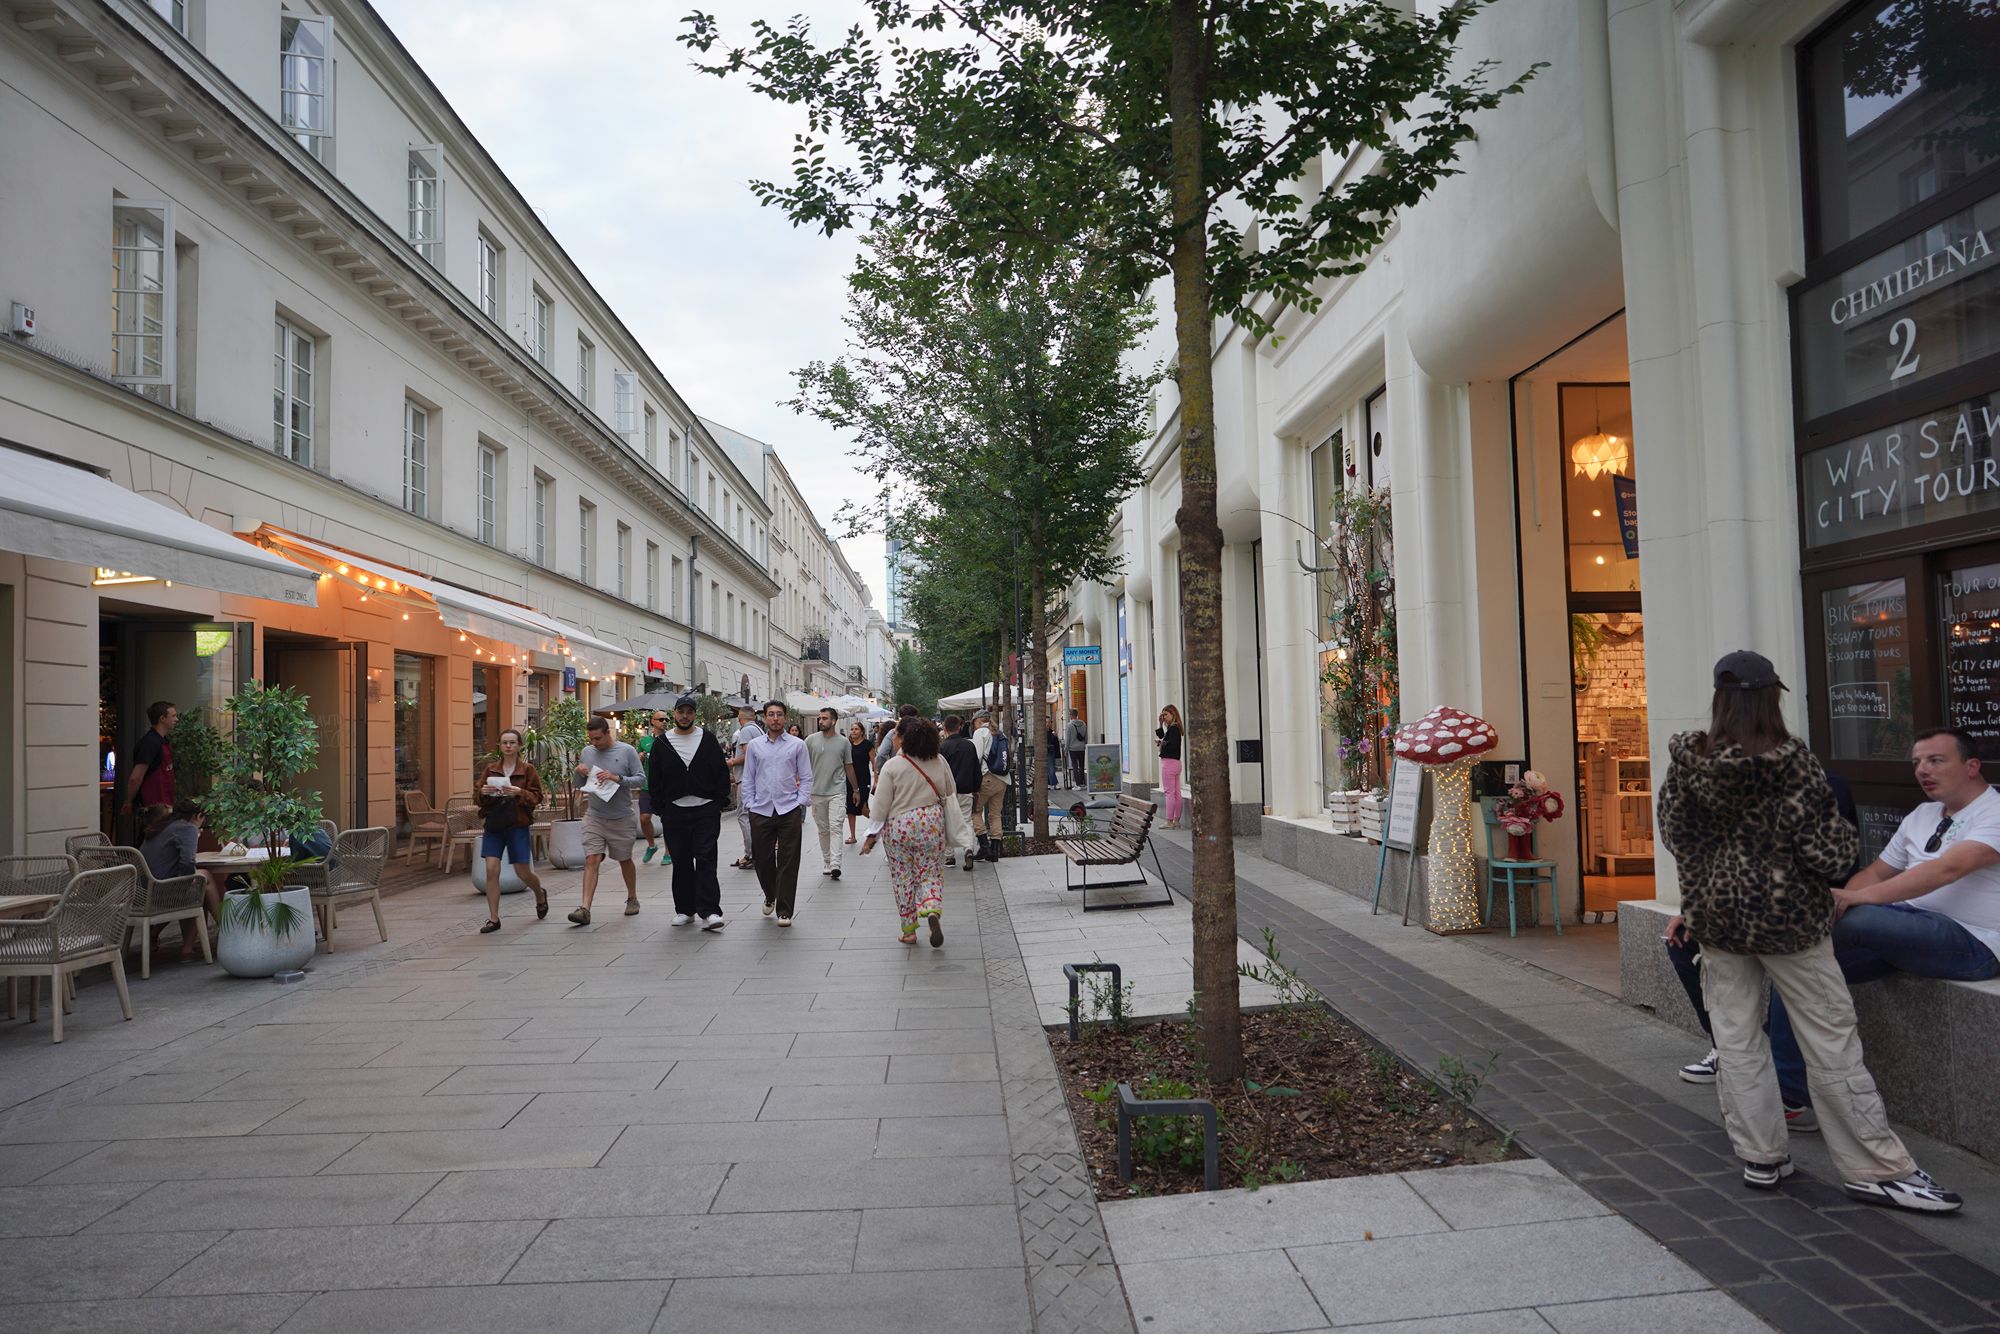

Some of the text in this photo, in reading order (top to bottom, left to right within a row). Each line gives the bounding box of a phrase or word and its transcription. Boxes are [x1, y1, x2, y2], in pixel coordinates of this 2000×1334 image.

[1830, 230, 1993, 324] CHMIELNA
[1889, 318, 1920, 380] 2
[1818, 479, 1897, 528] CITY
[1944, 578, 1980, 598] TOUR
[1828, 598, 1904, 626] BIKE TOURS
[1972, 608, 1999, 619] TOWN
[1827, 625, 1901, 646] SEGWAY TOURS
[1828, 648, 1901, 663] E-SCOOTER TOURS
[1865, 812, 1880, 822] OLD
